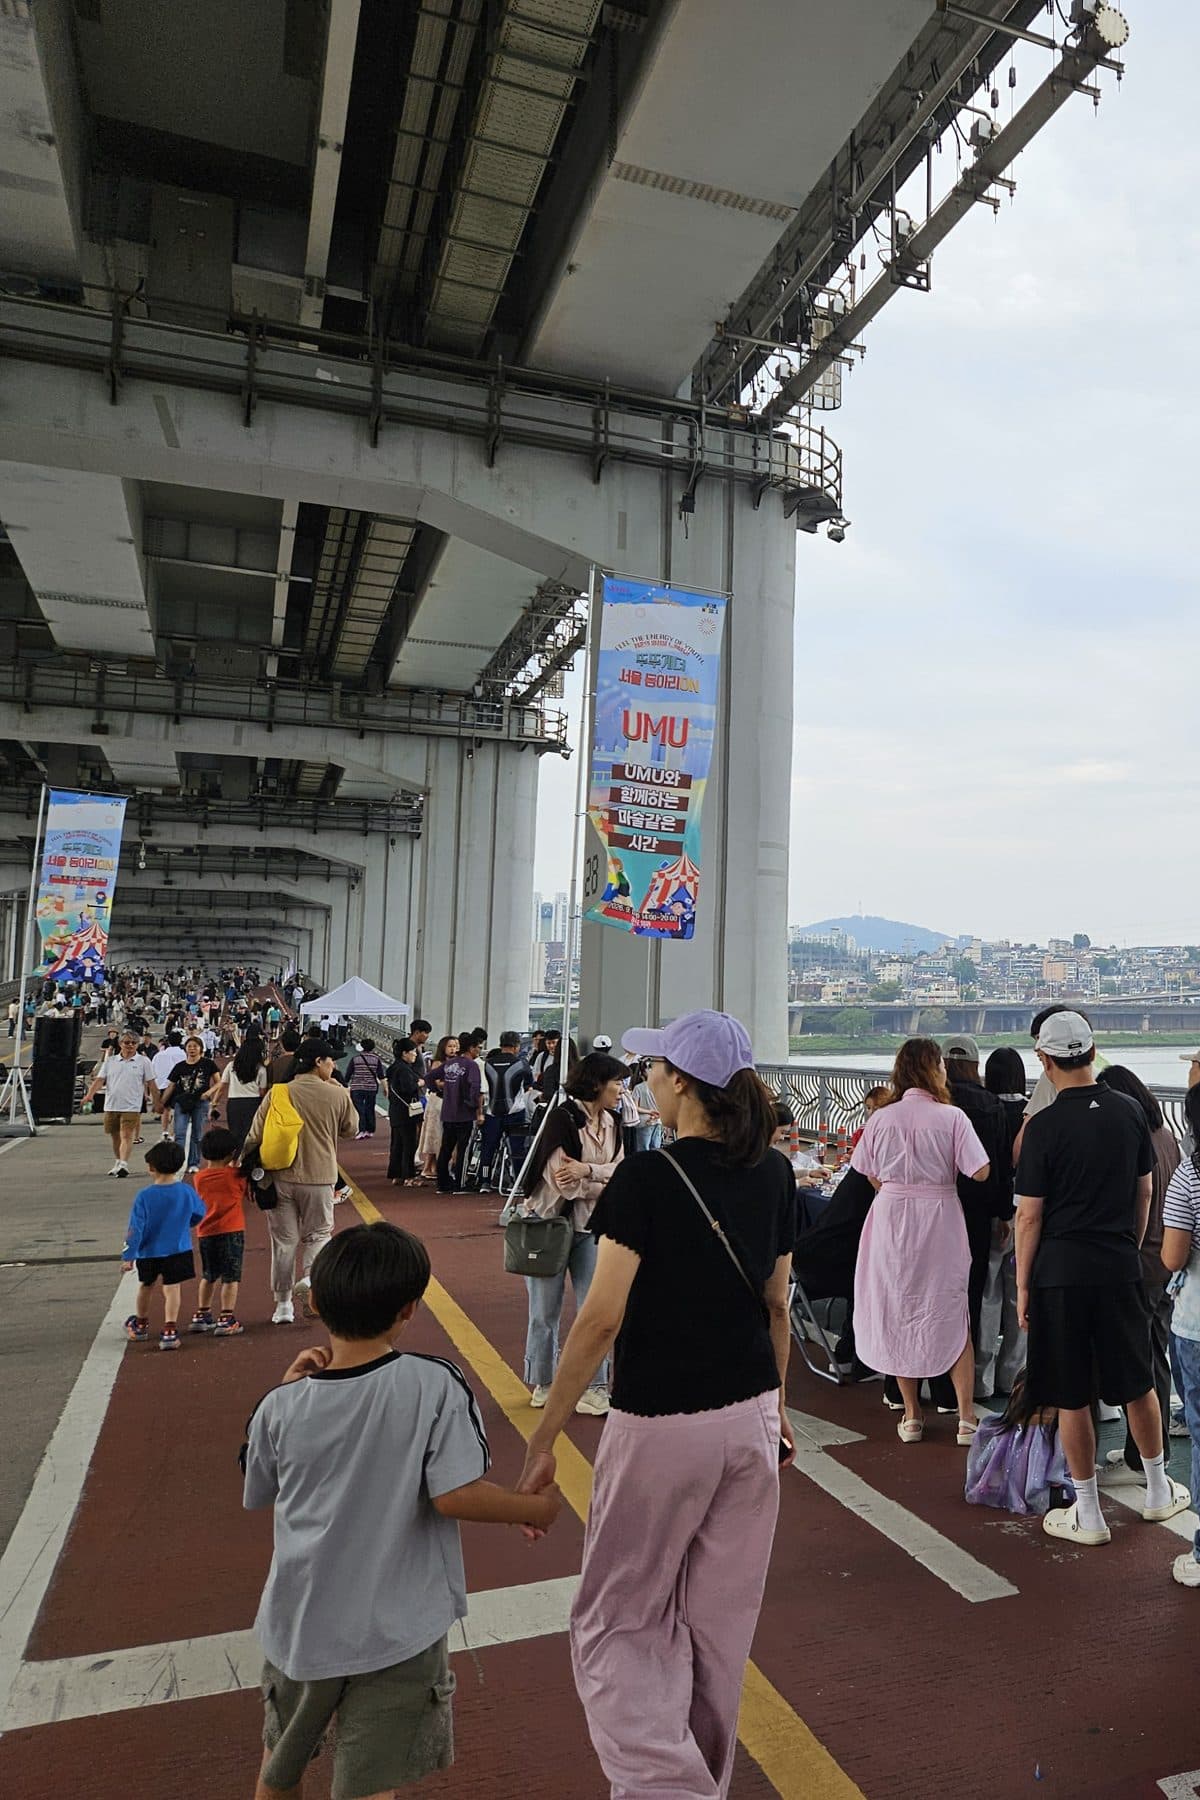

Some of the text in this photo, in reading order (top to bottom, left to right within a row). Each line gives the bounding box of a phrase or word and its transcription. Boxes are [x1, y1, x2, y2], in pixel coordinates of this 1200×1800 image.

[618, 668, 642, 687] 서울
[622, 709, 689, 748] UMU
[624, 763, 681, 787] UMU와
[620, 785, 680, 810] 함께하는
[618, 808, 677, 832] 마술같은
[628, 834, 659, 852] 시간
